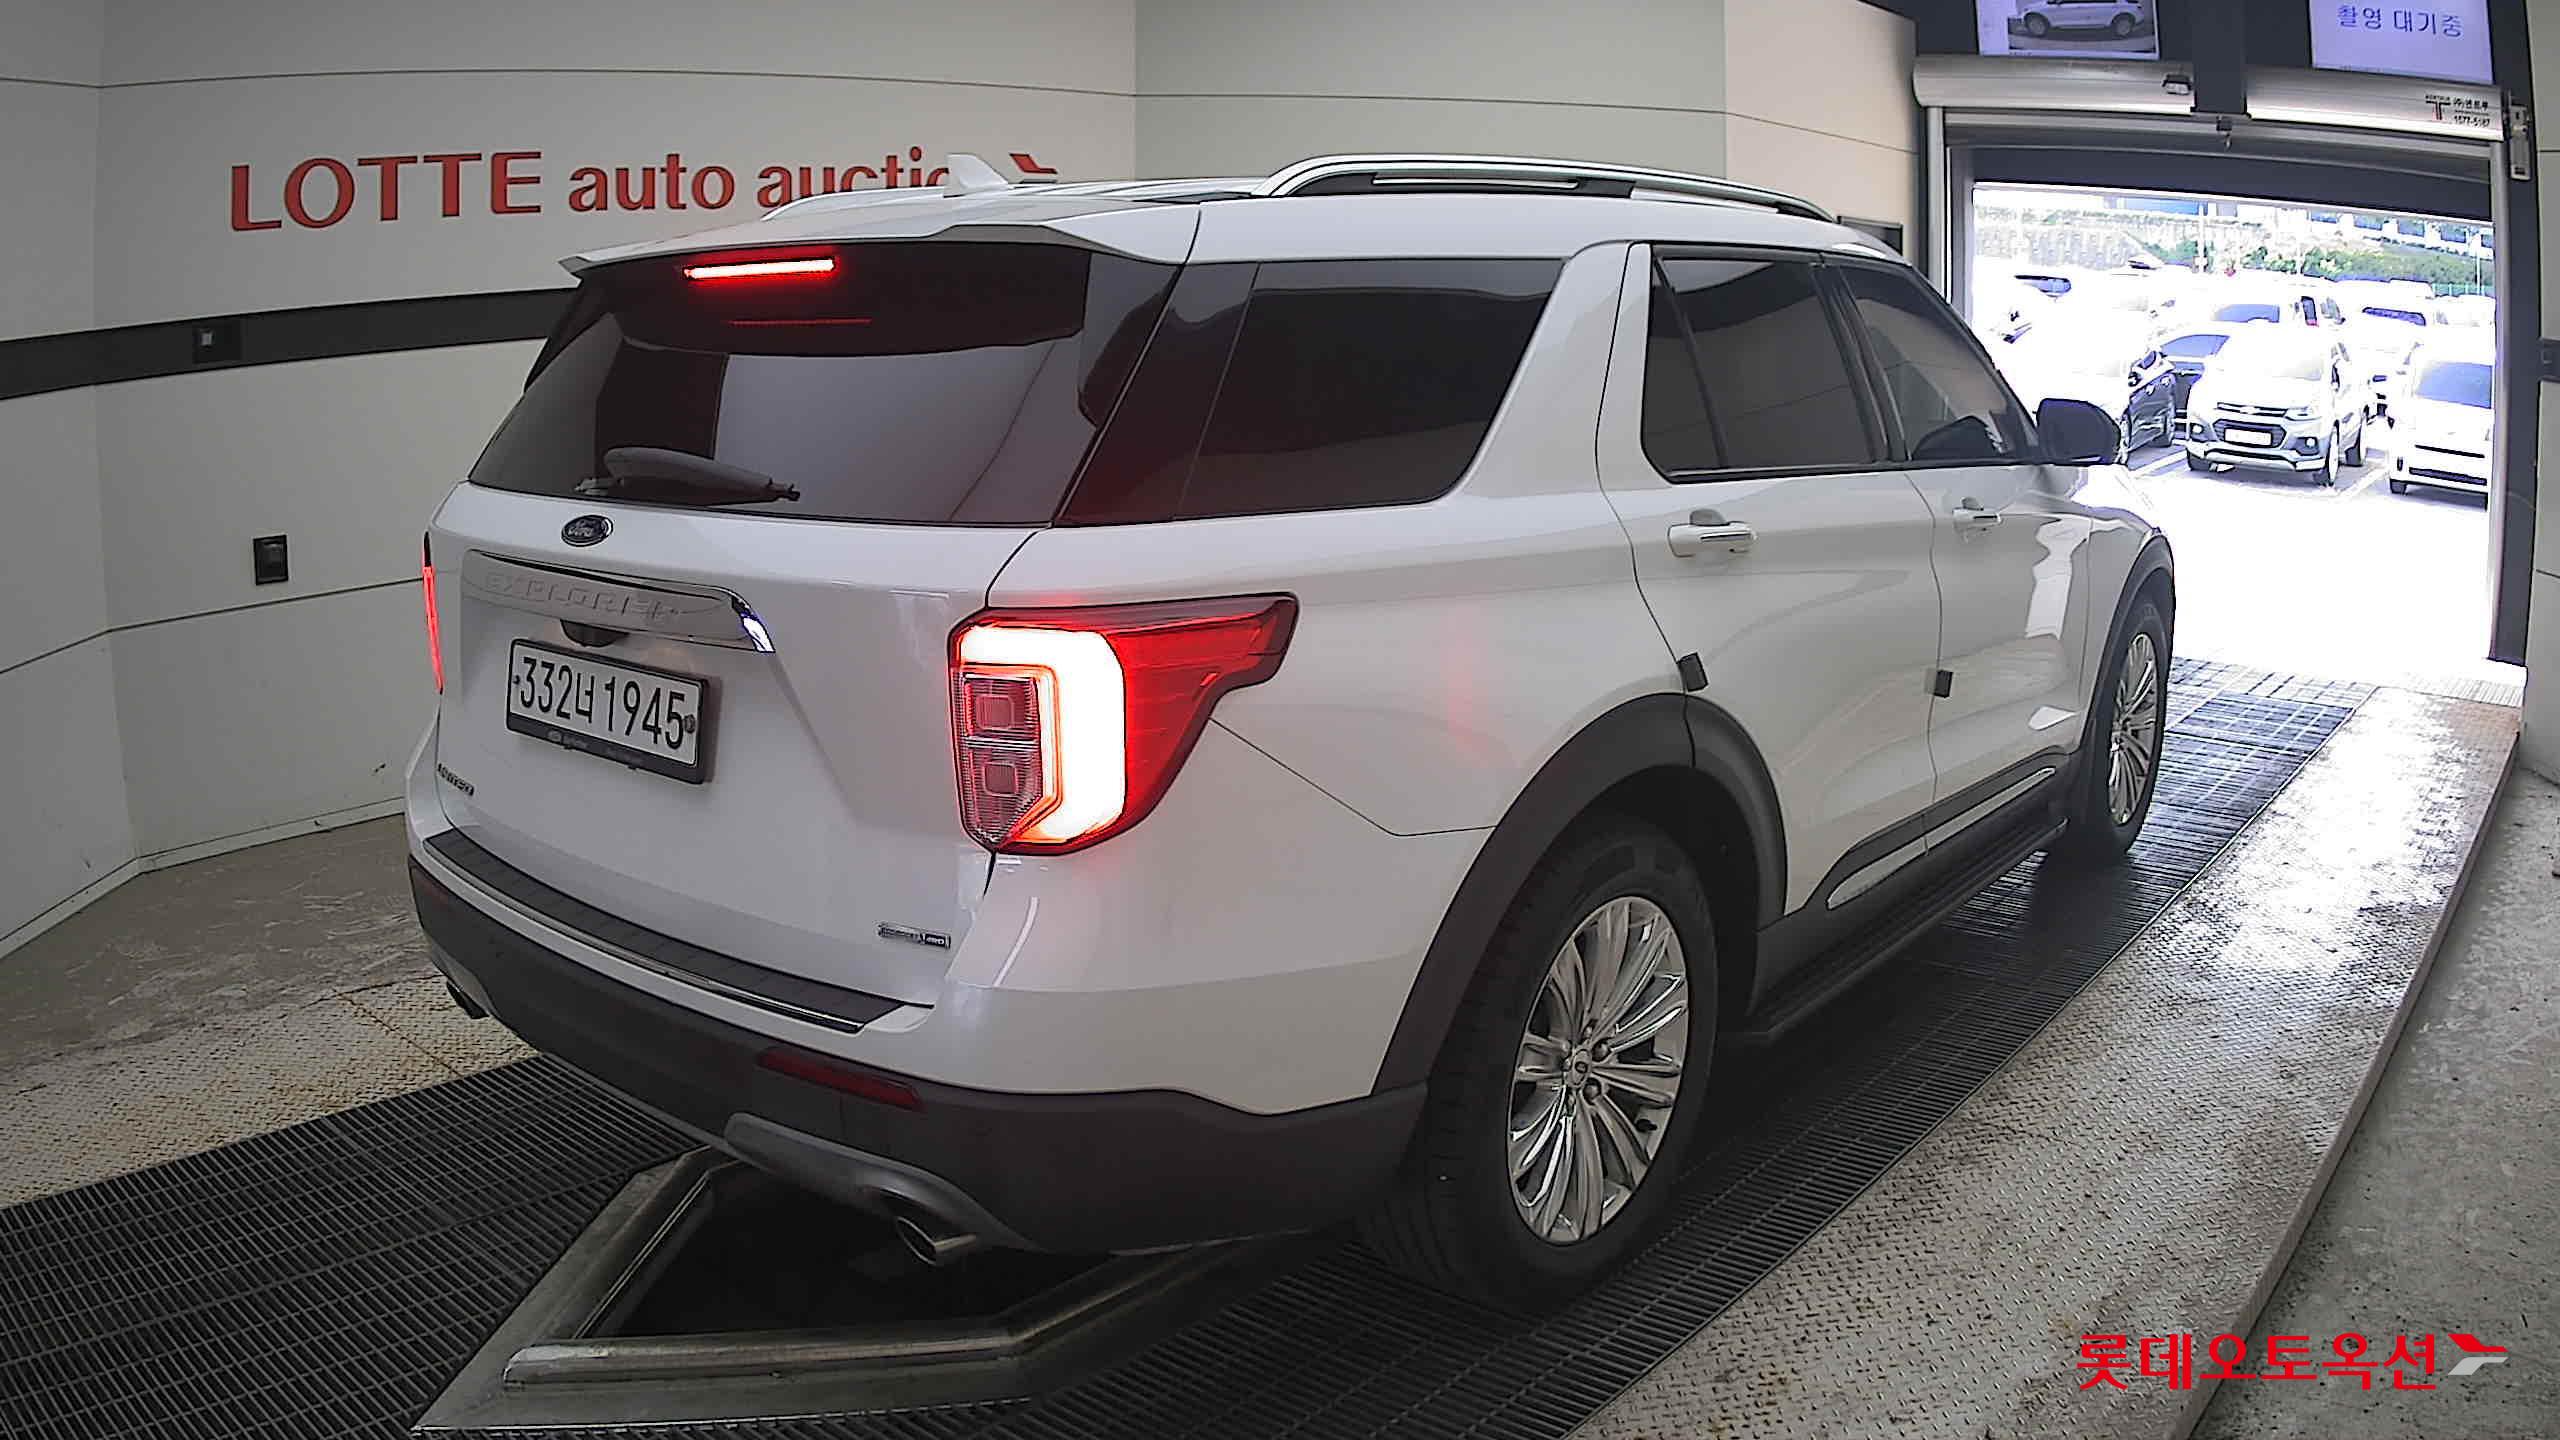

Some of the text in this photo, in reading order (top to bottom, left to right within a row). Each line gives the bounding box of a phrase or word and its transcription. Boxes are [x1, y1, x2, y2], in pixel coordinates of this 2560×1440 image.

[2338, 5, 2462, 38] 촬영 대기중
[231, 151, 542, 231] LOTTE
[568, 153, 736, 212] auto
